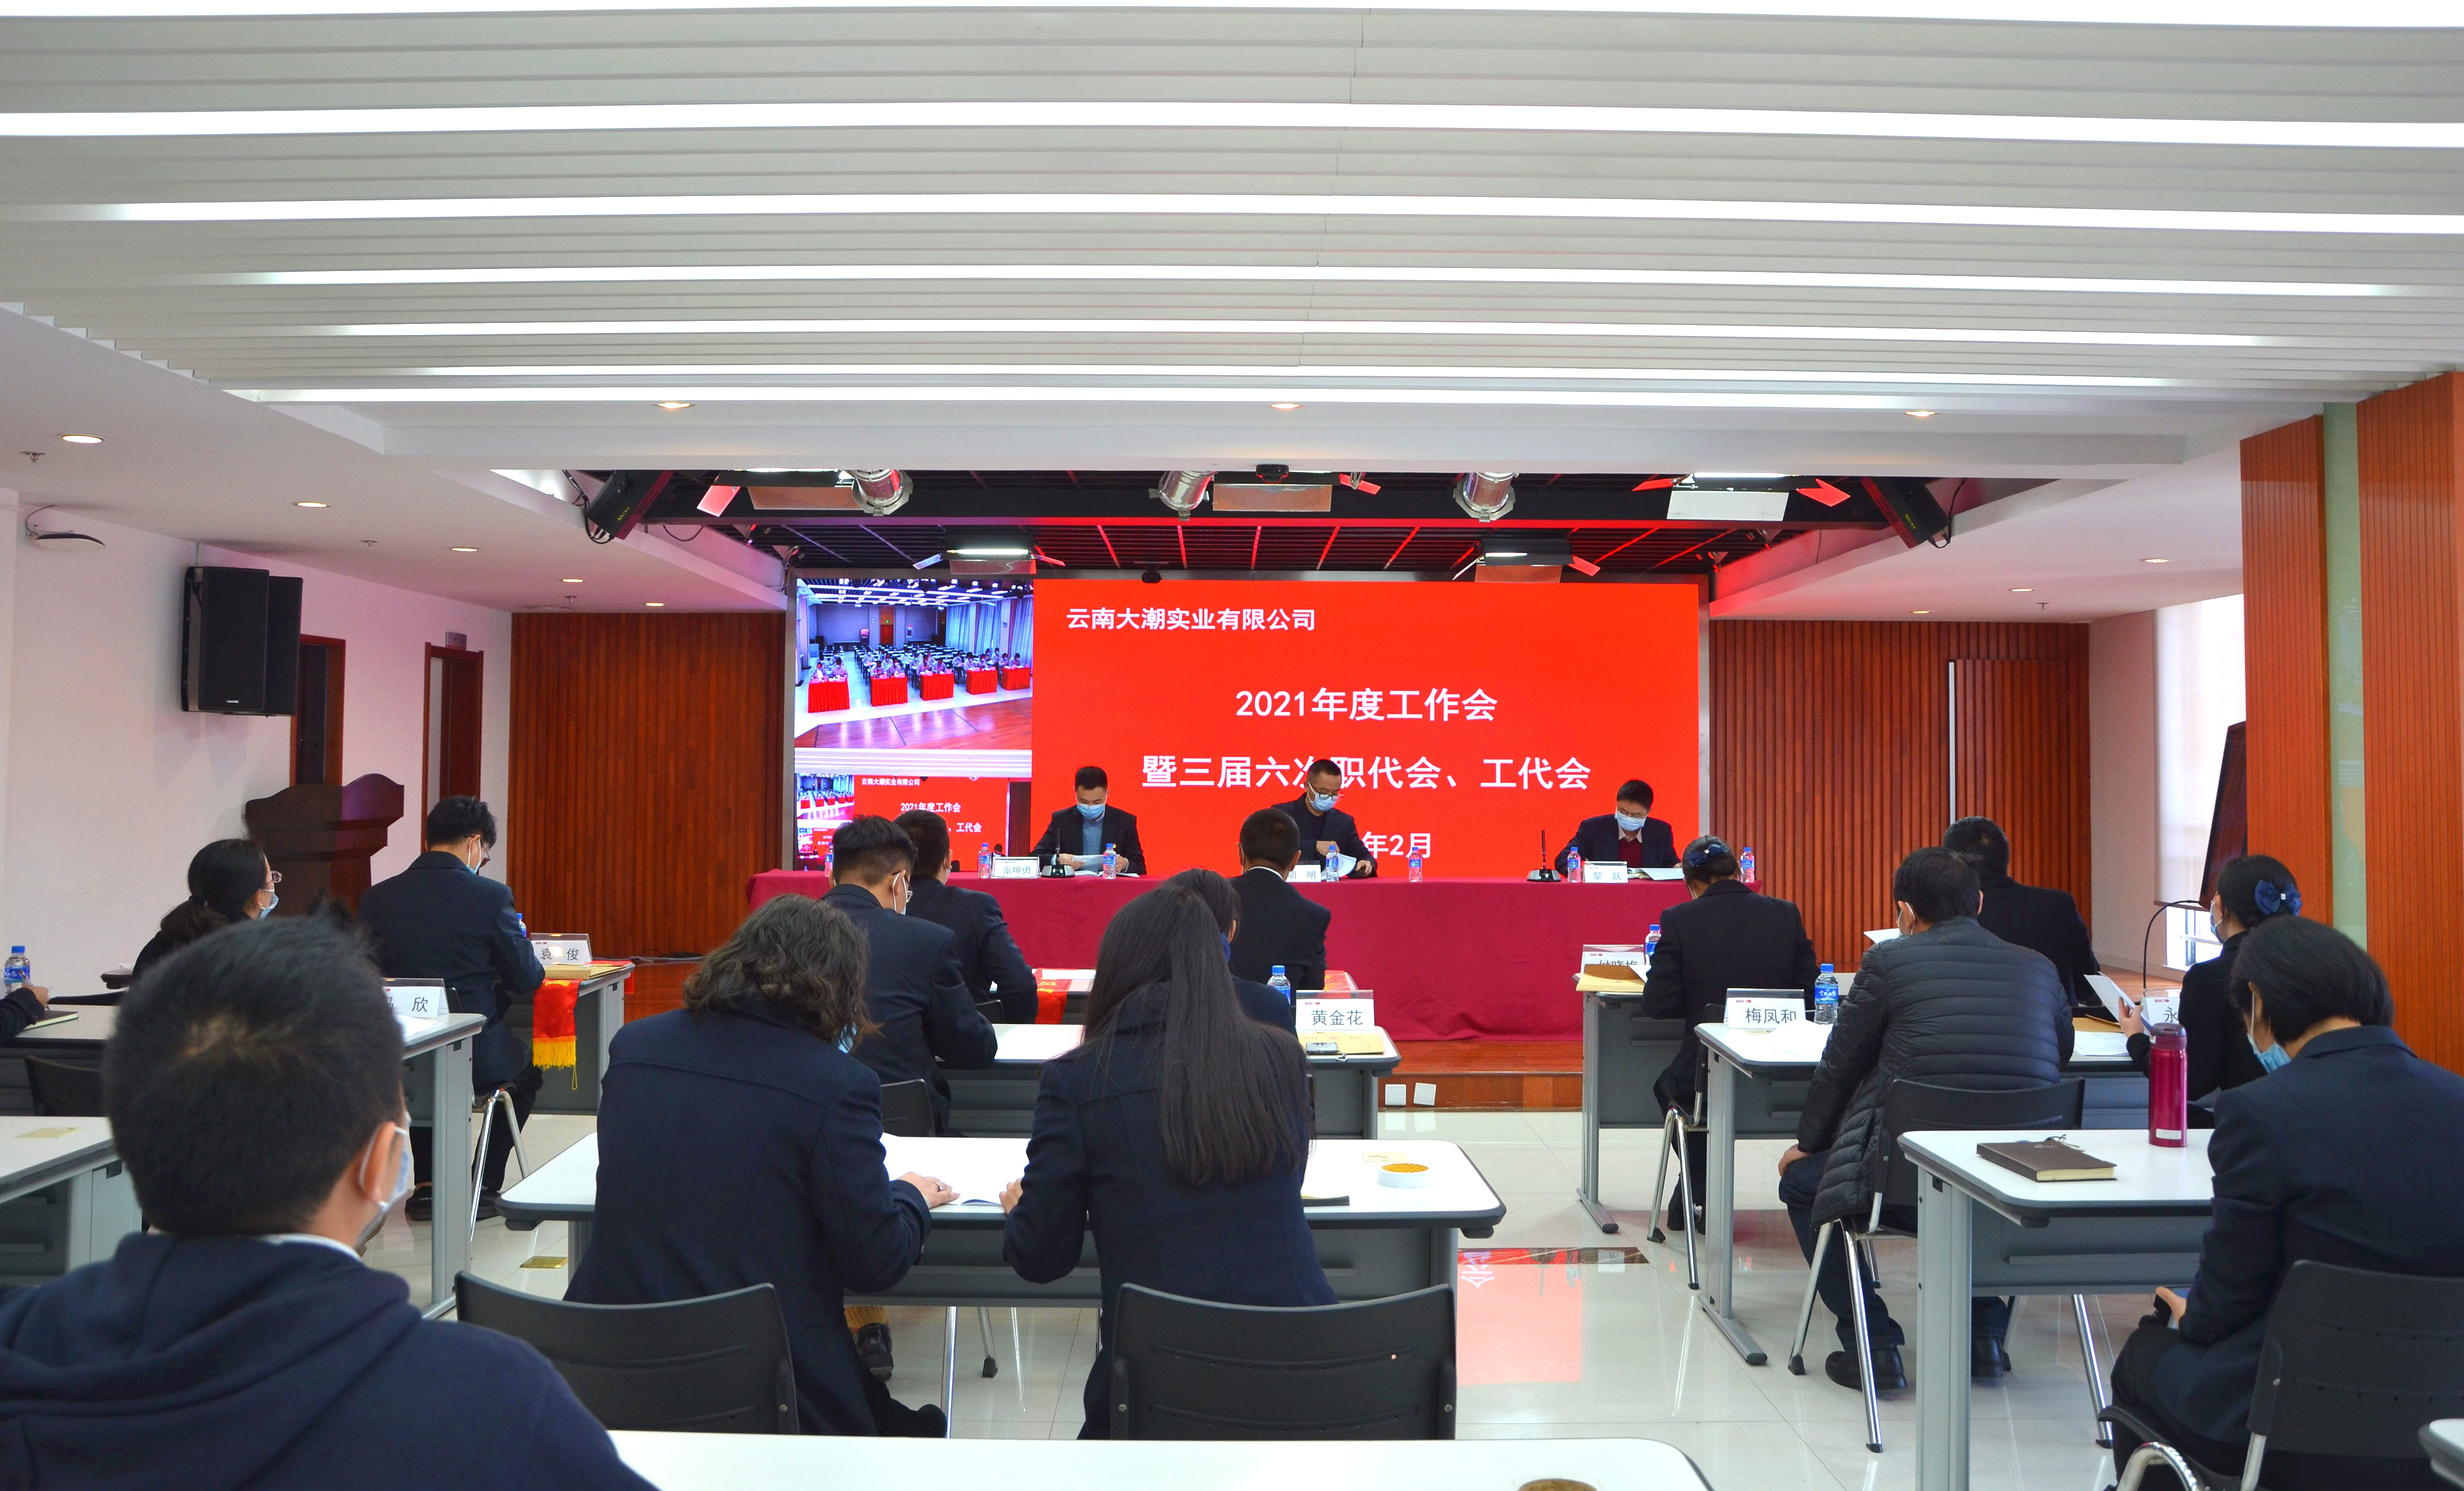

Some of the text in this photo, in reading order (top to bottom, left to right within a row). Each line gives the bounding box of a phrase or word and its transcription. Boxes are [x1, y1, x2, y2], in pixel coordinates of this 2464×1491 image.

[1066, 606, 1315, 631] 云南大潮实业有限公司
[1236, 687, 1498, 722] 2021年度工作会
[900, 802, 962, 813] 2021年度工作会
[1311, 1009, 1363, 1026] 黄金花
[1745, 1007, 1797, 1024] 梅凤和
